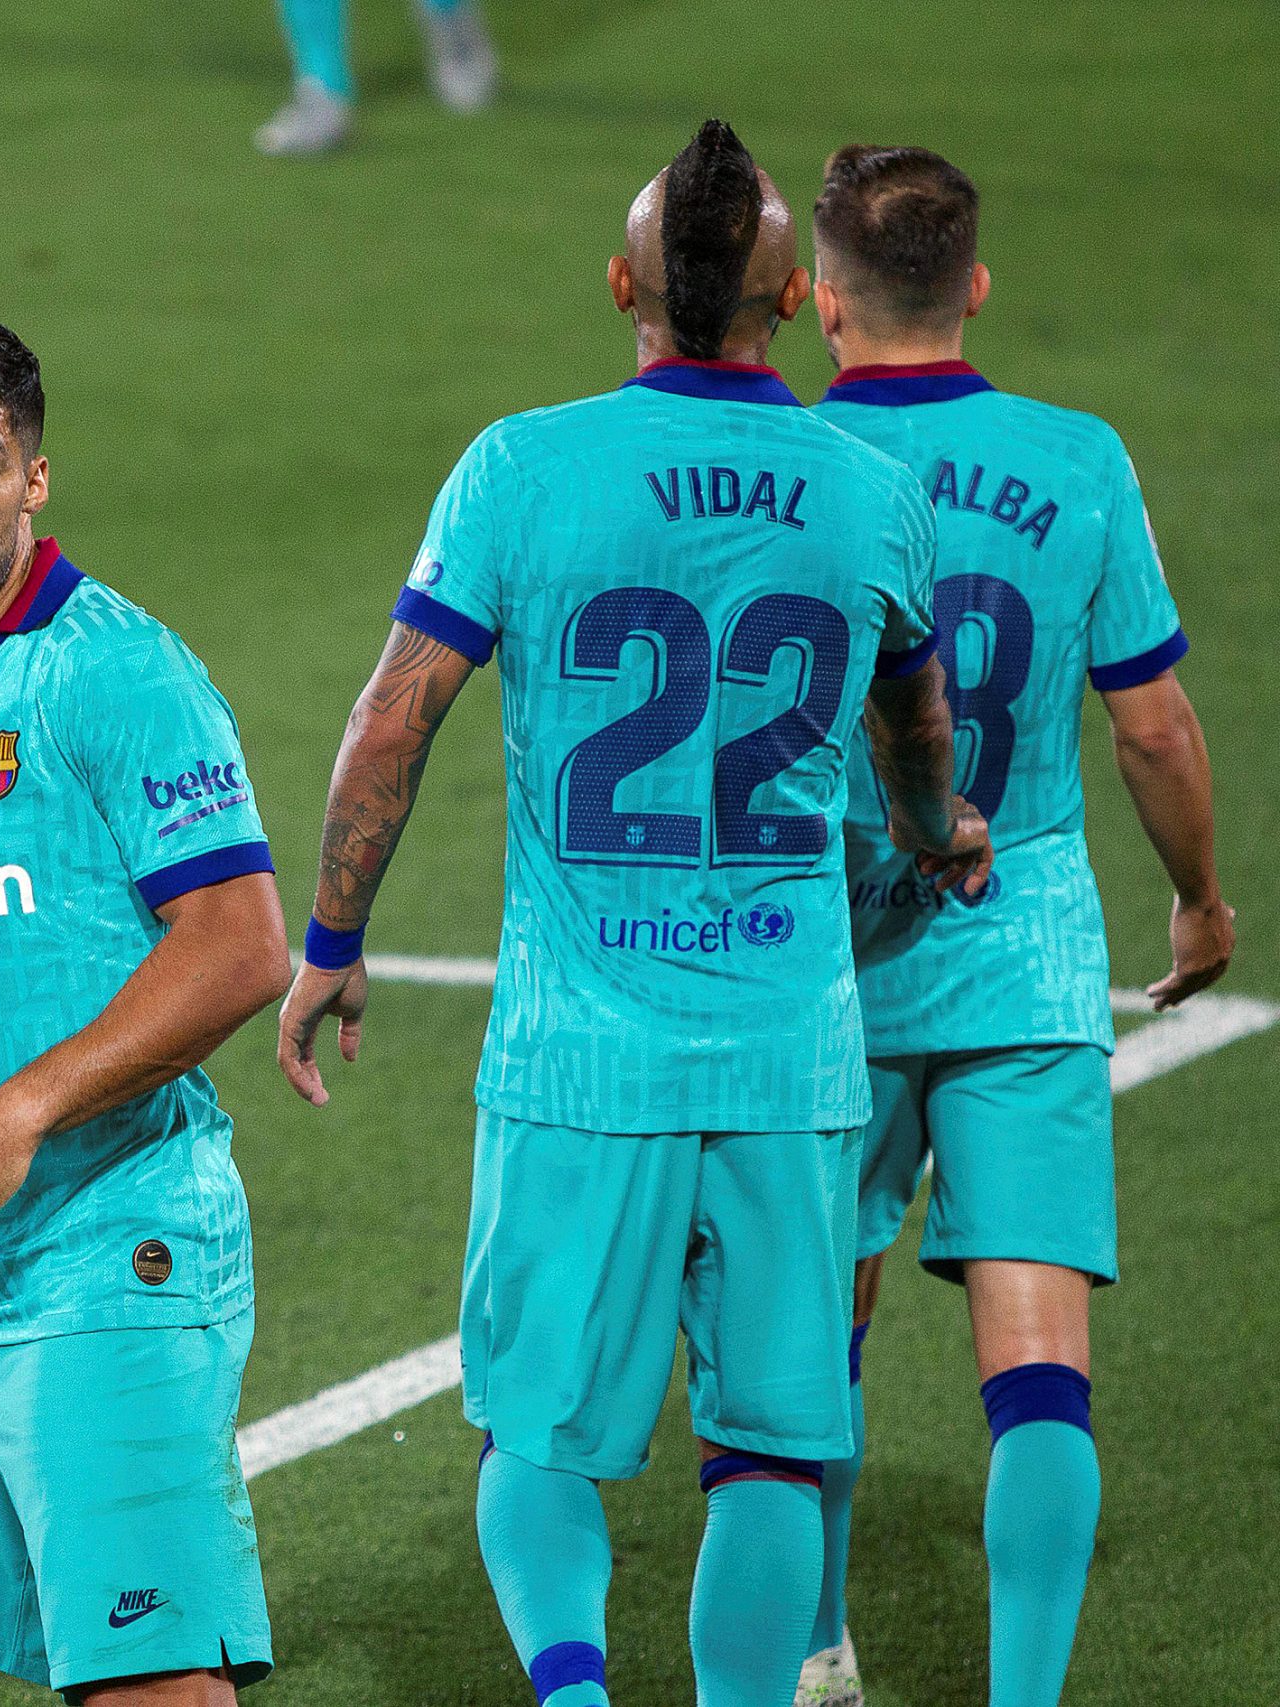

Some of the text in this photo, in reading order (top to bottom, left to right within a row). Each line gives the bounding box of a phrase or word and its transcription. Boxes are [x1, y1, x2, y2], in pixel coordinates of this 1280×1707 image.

[644, 465, 808, 531] VIDAL
[930, 459, 1060, 552] ALBA
[556, 586, 851, 871] 22
[599, 907, 734, 953] unicef
[116, 1588, 159, 1612] NIKE
